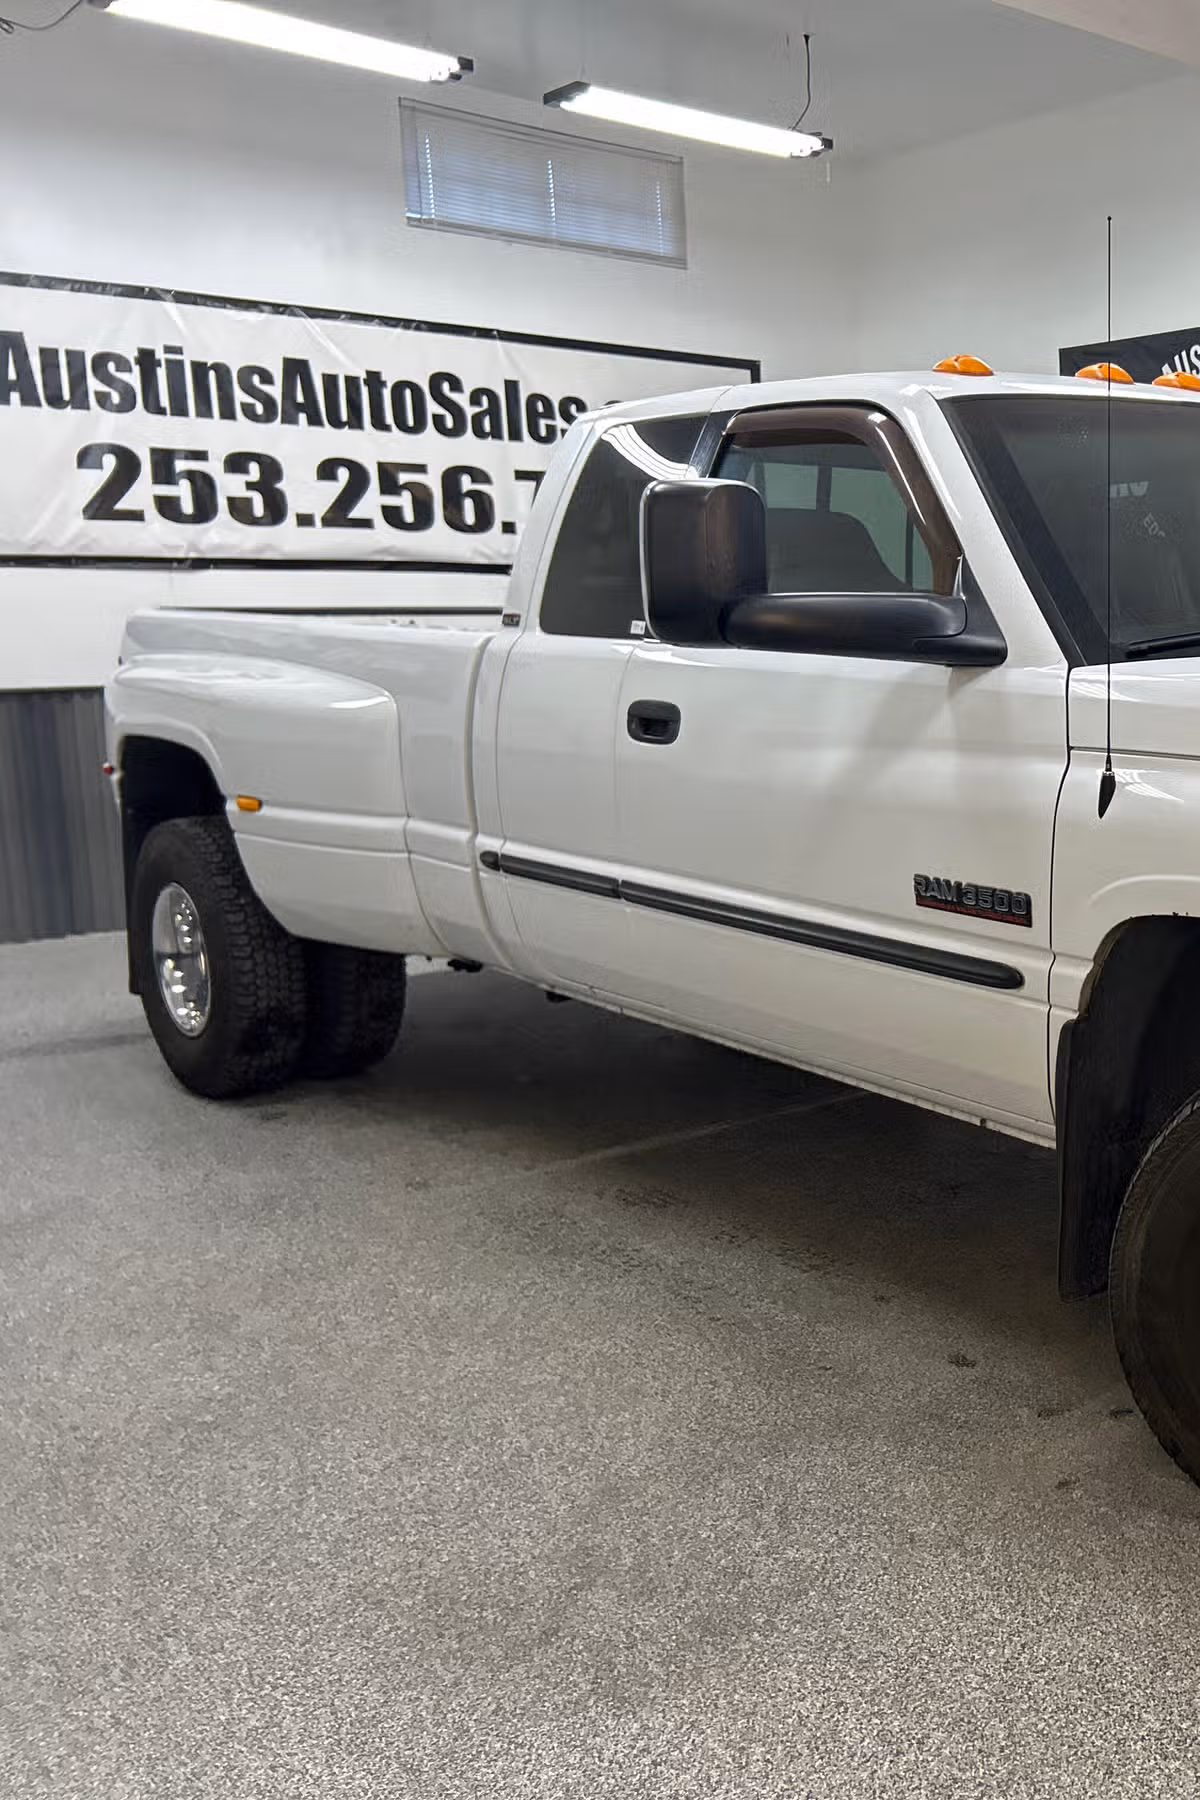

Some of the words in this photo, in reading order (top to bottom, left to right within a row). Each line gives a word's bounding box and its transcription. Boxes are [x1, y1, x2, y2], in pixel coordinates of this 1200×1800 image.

[0, 330, 624, 445] AustinsAutoSales
[913, 874, 961, 902] RAM
[962, 884, 1029, 915] 3500
